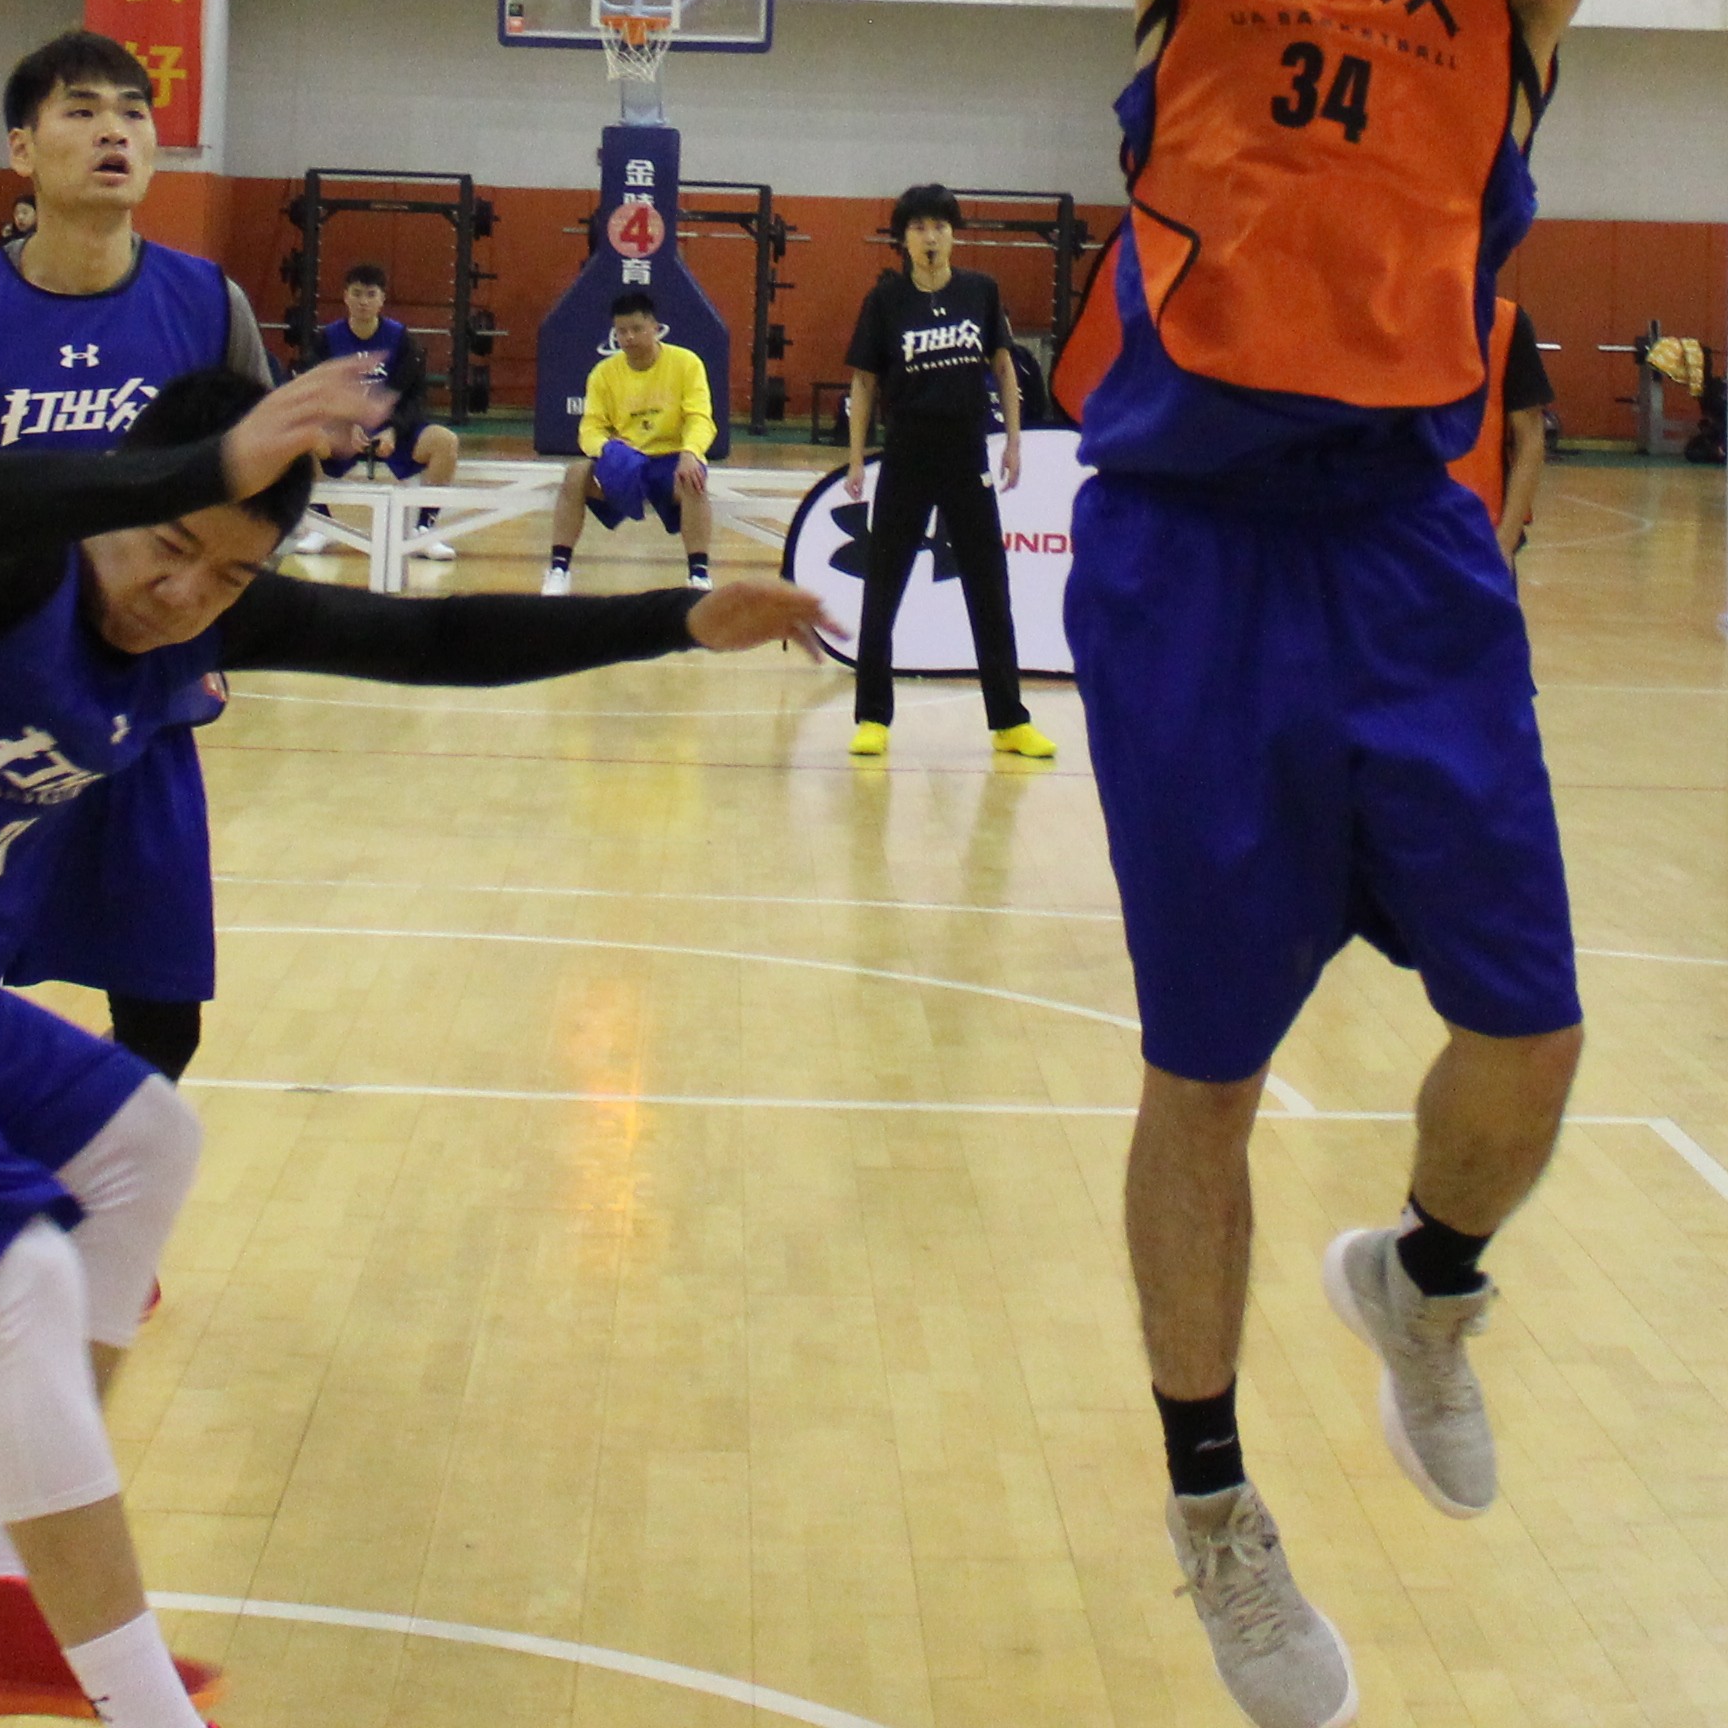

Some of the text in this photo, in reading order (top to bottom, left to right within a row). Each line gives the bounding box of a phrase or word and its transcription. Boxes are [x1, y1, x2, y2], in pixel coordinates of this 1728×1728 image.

[1271, 41, 1372, 144] 34
[619, 206, 654, 253] 4
[901, 318, 983, 363] 打出众
[1003, 532, 1074, 553] ND
